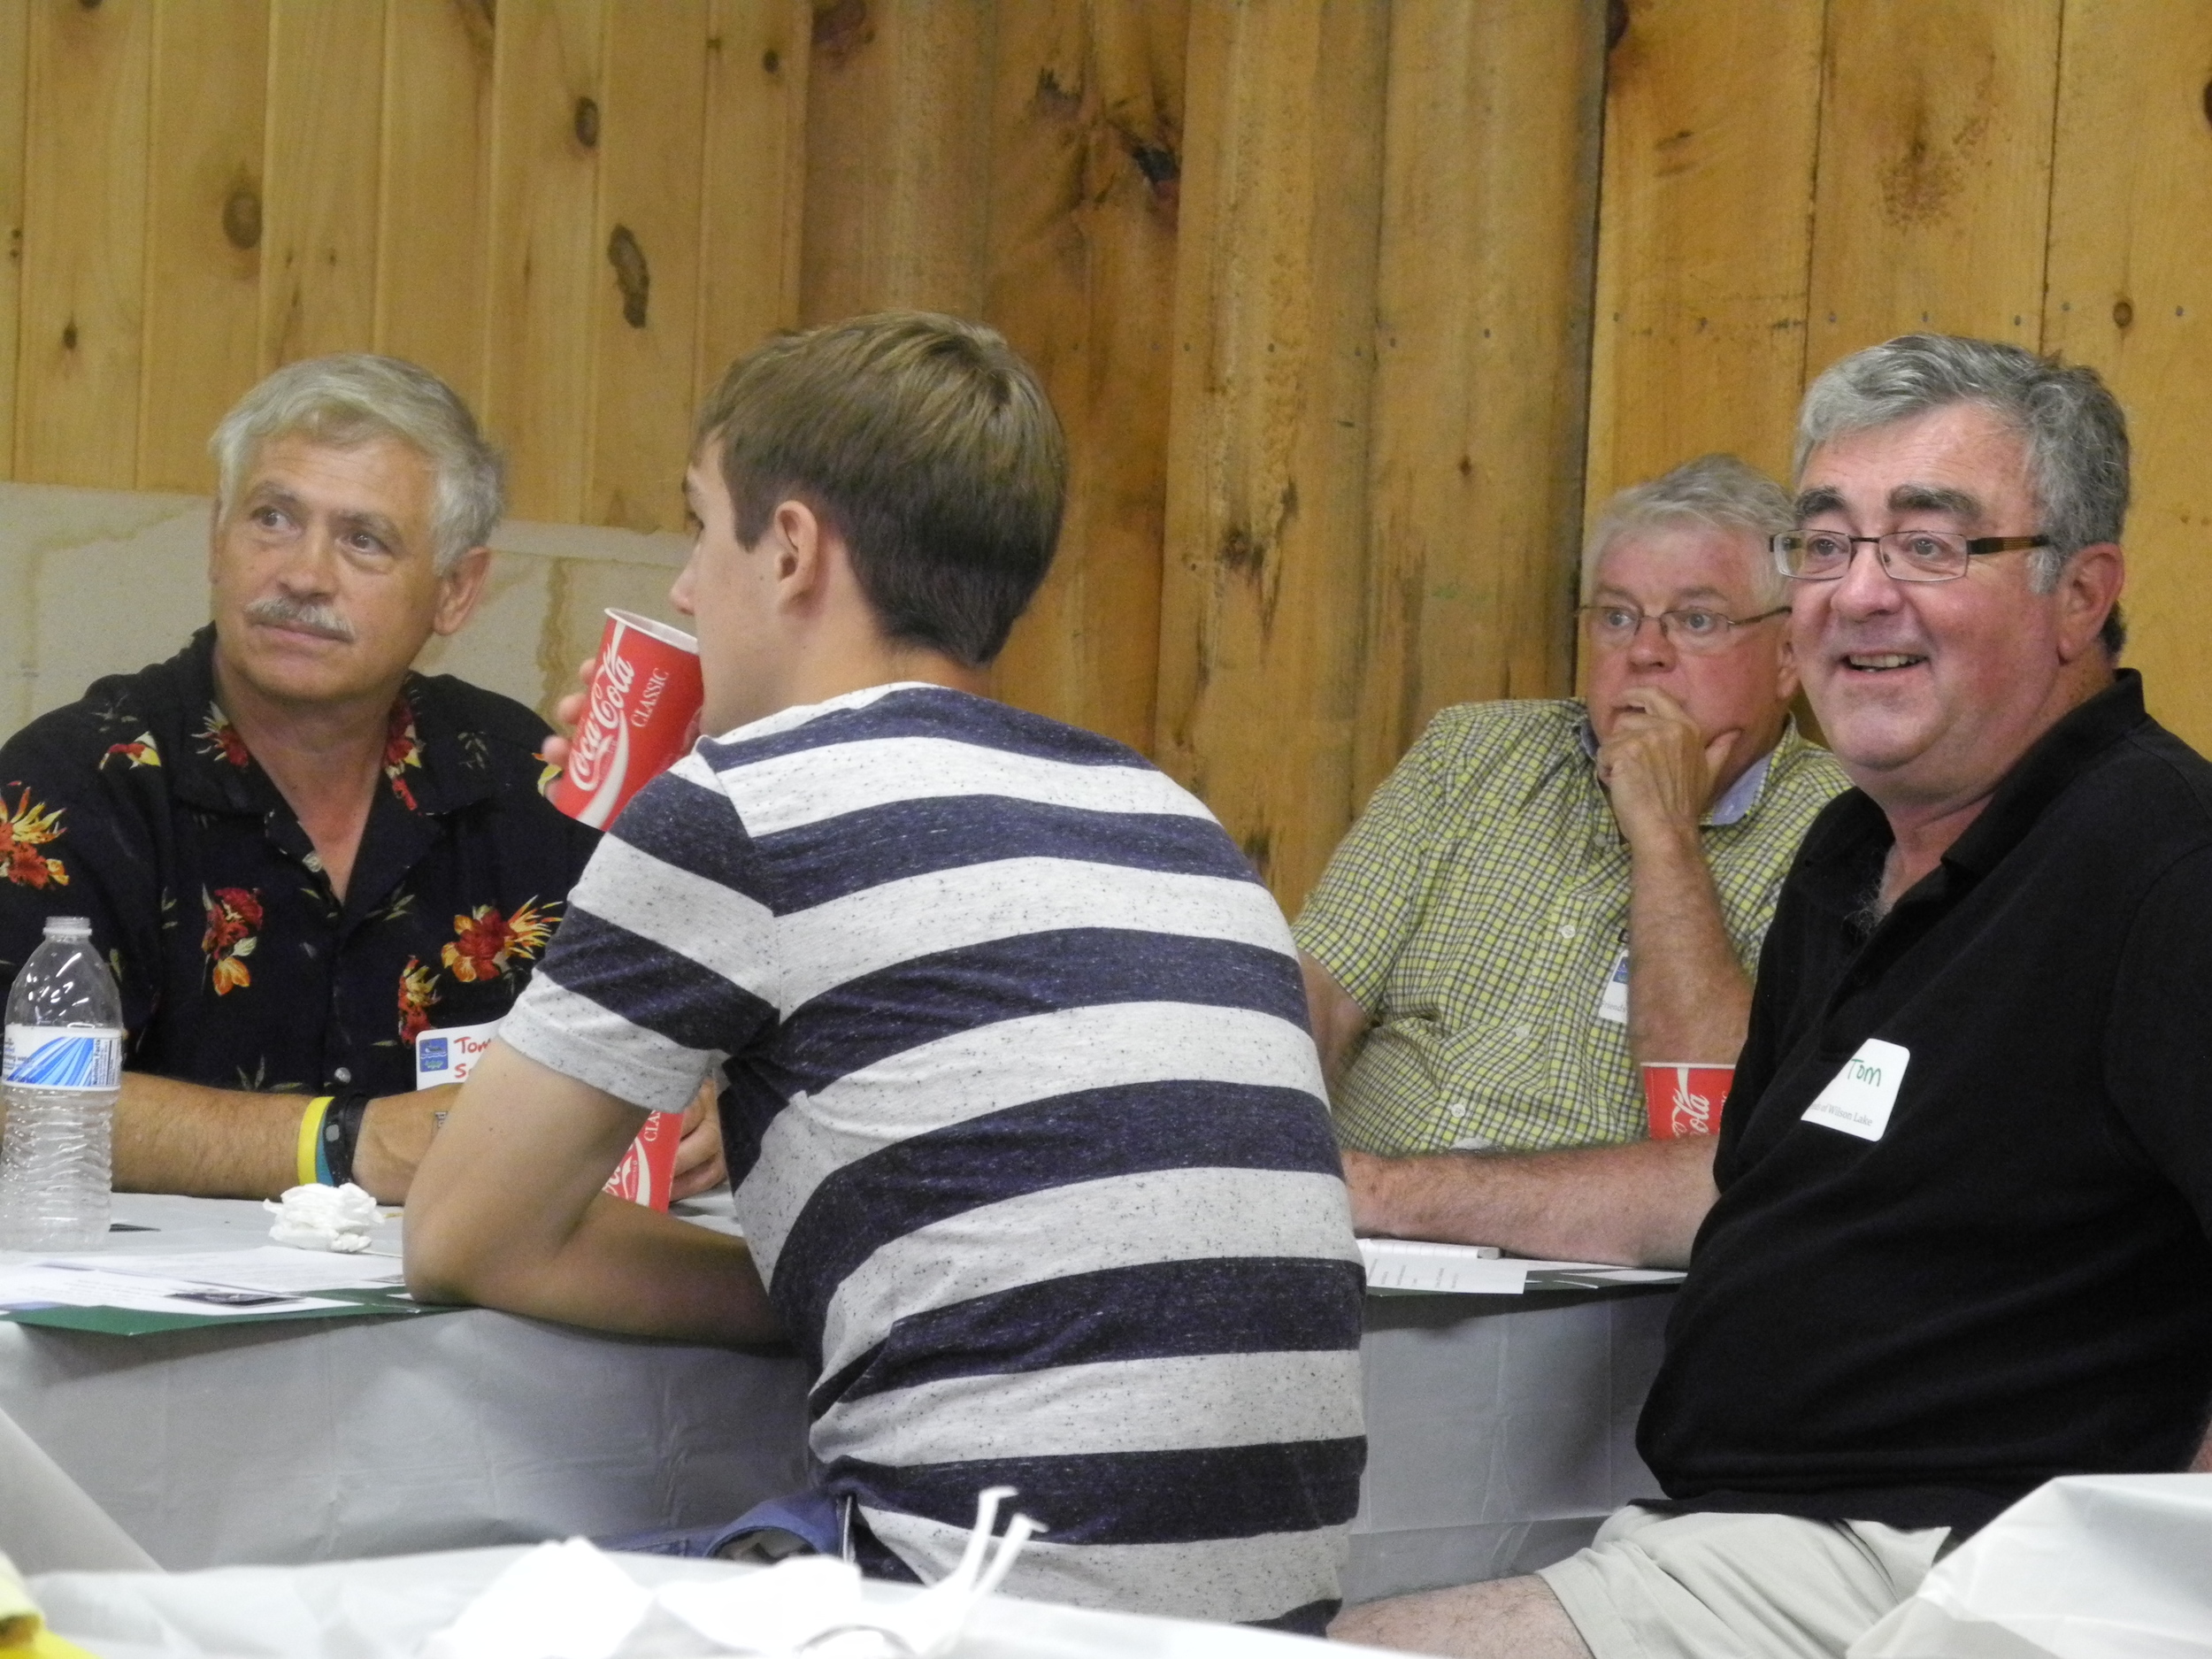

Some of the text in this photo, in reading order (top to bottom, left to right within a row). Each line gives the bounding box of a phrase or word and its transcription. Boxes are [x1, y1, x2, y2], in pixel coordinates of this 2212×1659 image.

[631, 668, 670, 727] CLASSIC
[454, 1063, 472, 1079] S
[1847, 1058, 1882, 1087] Tom
[643, 1110, 662, 1141] CLA
[1827, 1102, 1853, 1121] Wilson
[1853, 1111, 1873, 1126] Lake
